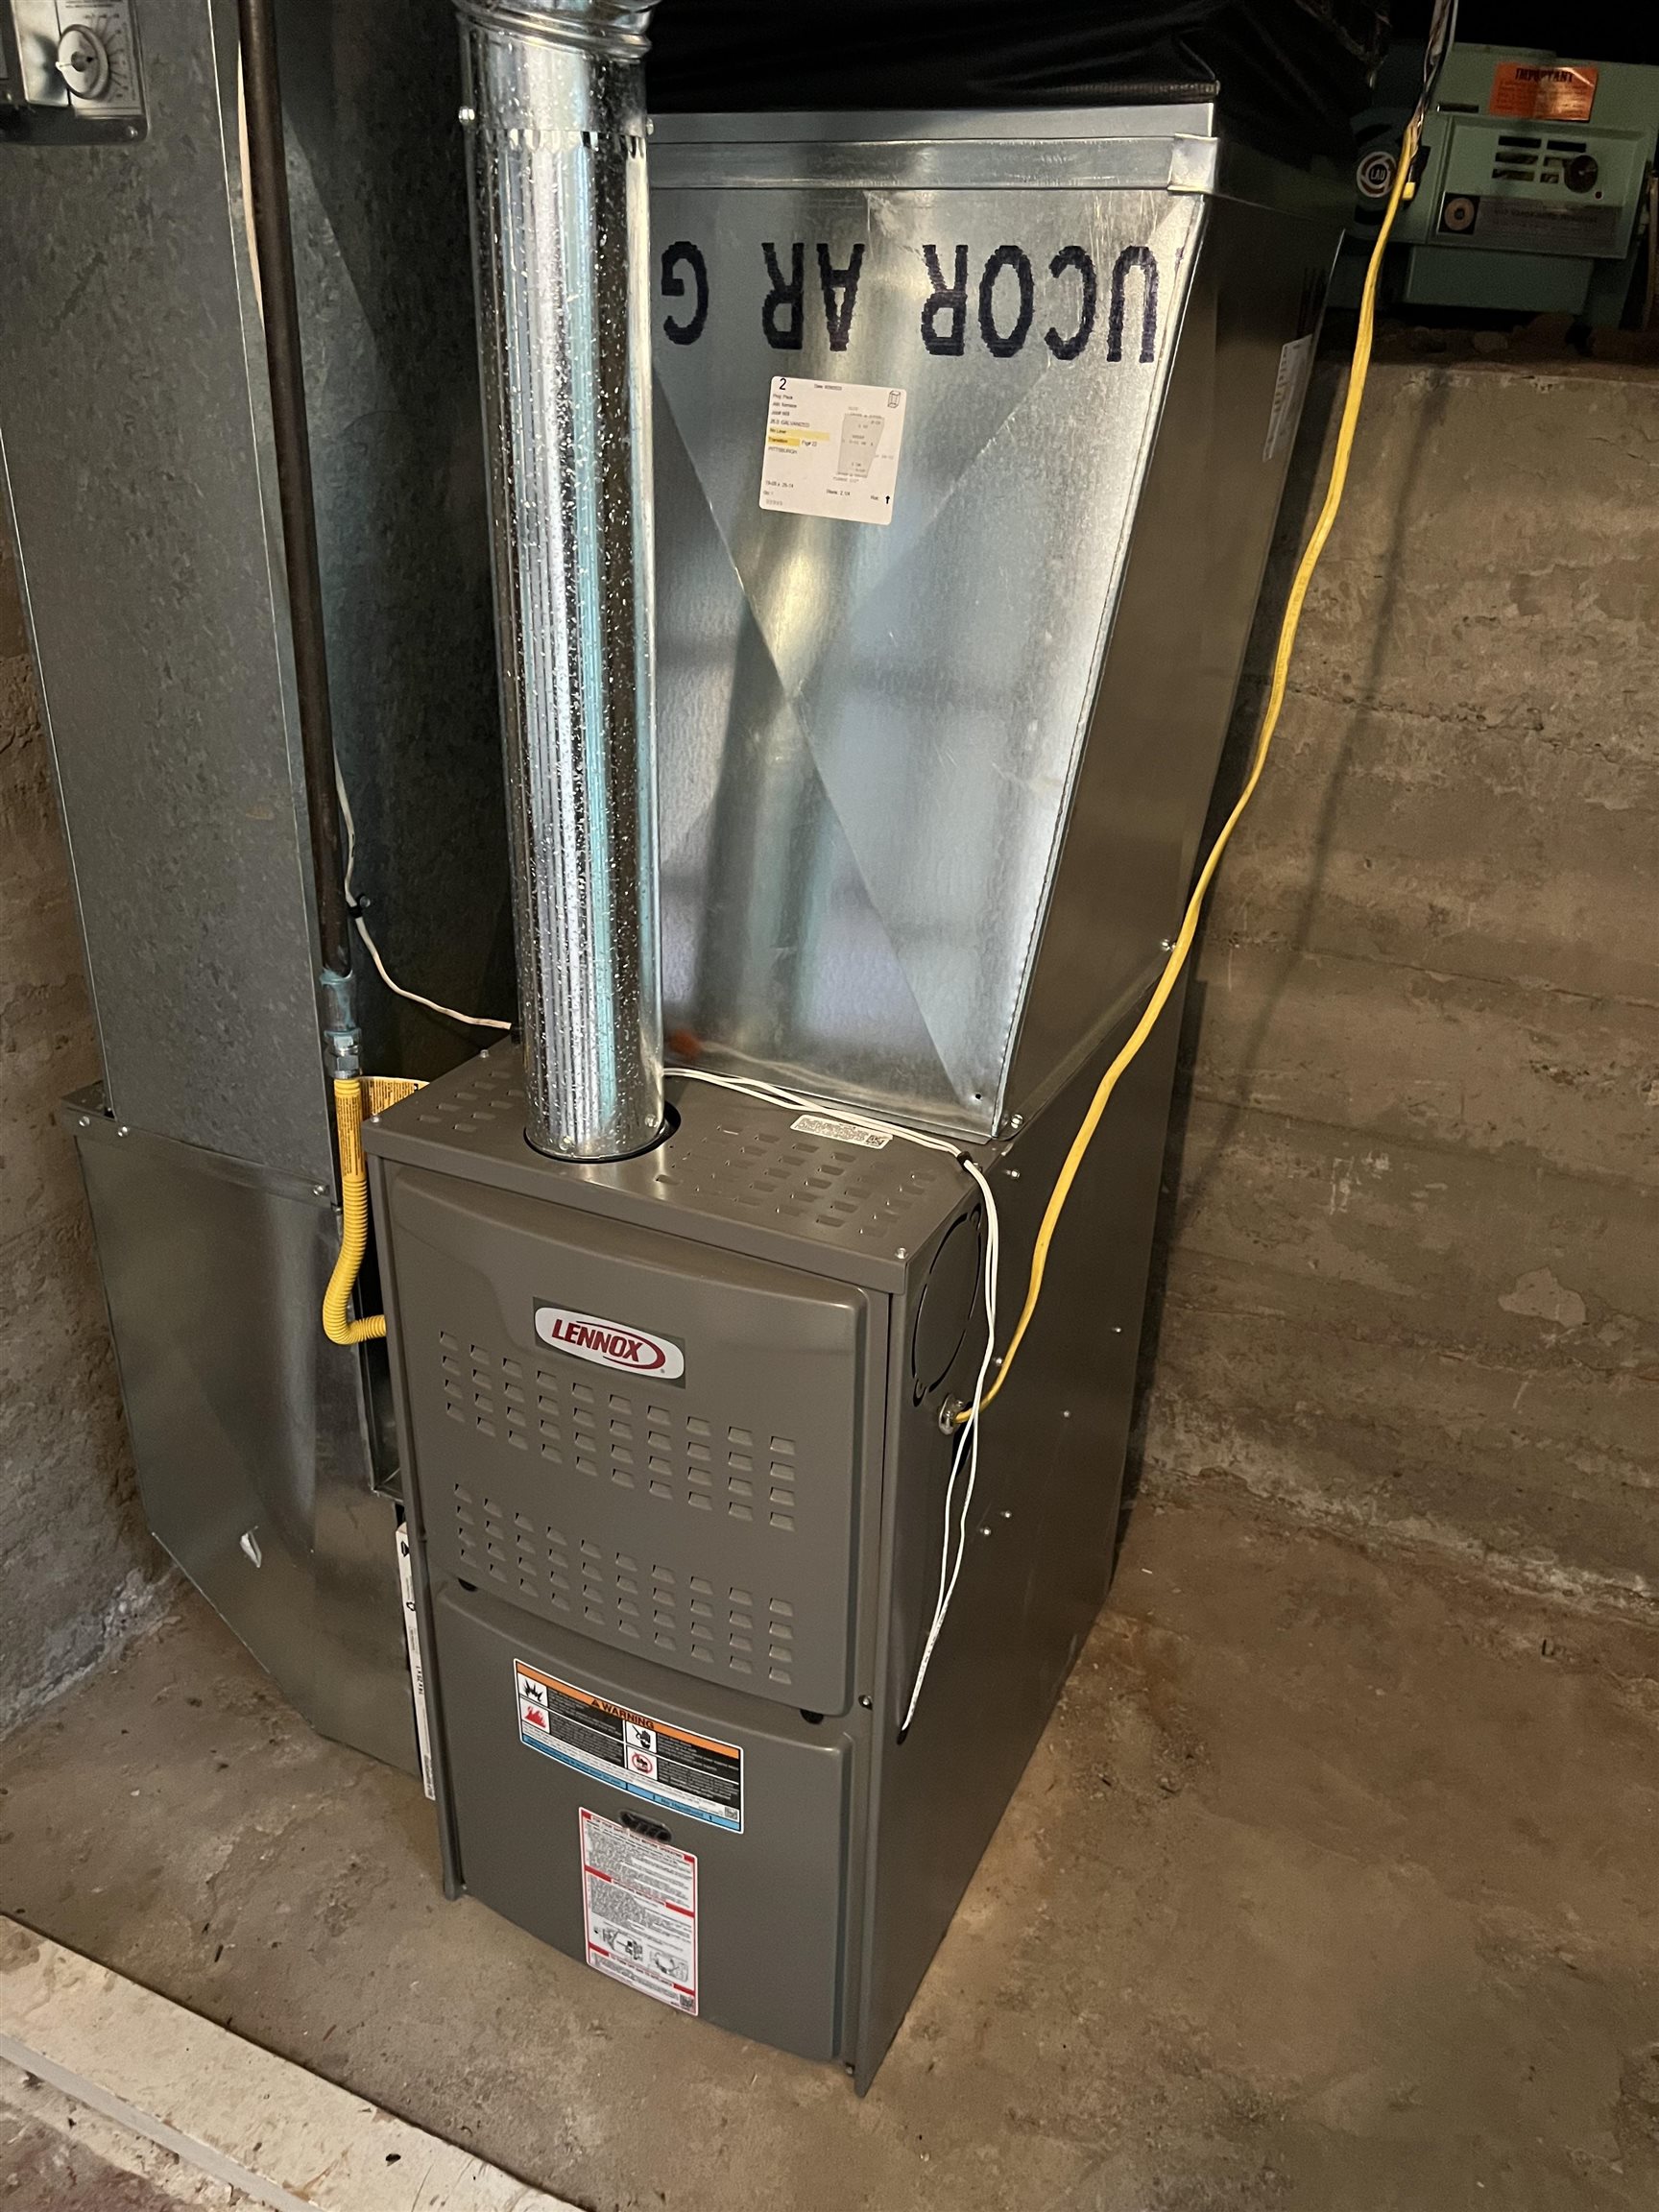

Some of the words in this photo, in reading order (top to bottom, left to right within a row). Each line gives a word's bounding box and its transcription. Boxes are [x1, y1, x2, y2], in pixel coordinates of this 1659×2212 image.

[661, 240, 709, 346] G
[761, 241, 867, 352] AR
[779, 377, 787, 391] 2
[551, 1318, 643, 1363] LENNOX
[601, 1701, 655, 1730] WARNING
